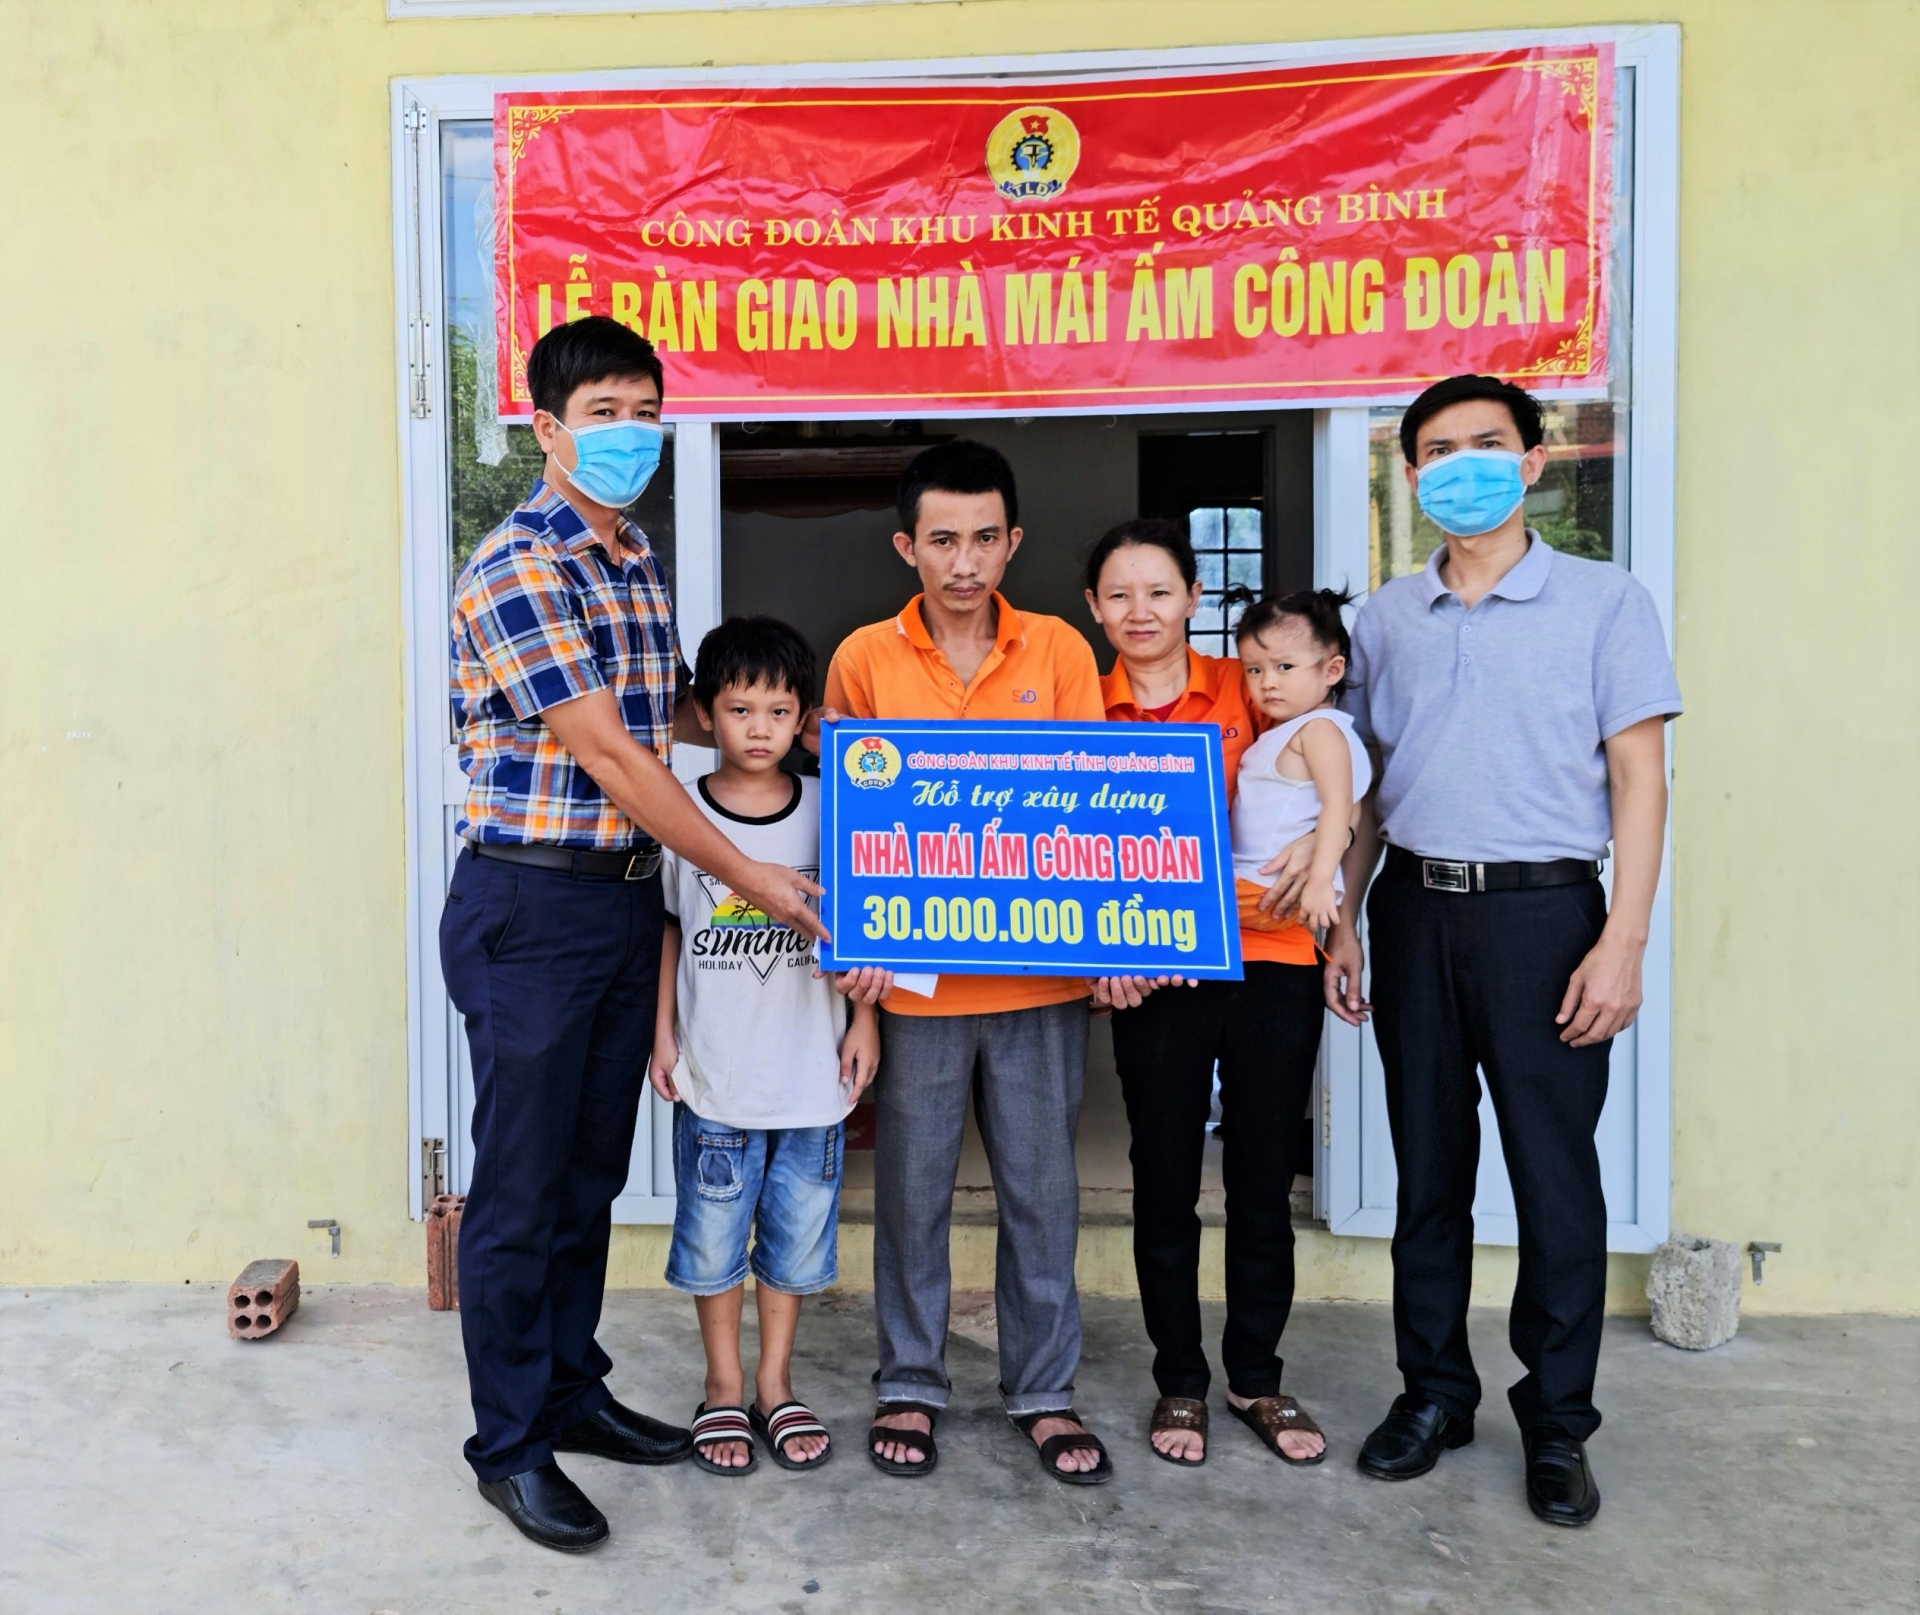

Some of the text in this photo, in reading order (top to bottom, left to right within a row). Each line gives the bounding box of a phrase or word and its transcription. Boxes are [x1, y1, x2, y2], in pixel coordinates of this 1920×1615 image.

[641, 184, 1447, 247] CÔNG ĐOÀN KHU KINH TẾ QUẢNG BÌNH
[612, 265, 717, 352] BÀN
[737, 278, 858, 351] GIAO
[877, 262, 987, 349] NHÀ
[1005, 255, 1107, 346] MÁI
[1126, 242, 1213, 342] ẤM
[1233, 247, 1385, 338] CÔNG
[1403, 236, 1565, 331] ĐOÀN
[907, 751, 946, 770] CÔNG
[947, 751, 988, 769] ĐOÀN
[989, 754, 1020, 770] KHU
[1020, 755, 1054, 771] KINH
[1054, 751, 1074, 771] TẾ
[1107, 752, 1159, 774] QUẢNG
[1159, 754, 1195, 773] BÌNH
[911, 780, 1169, 816] Hỗ trợ xây dựng
[852, 818, 1202, 883] NHÀ MÁI ẤM CÔNG ĐOÀN
[863, 894, 1197, 953] 30.000.000 đồng
[698, 960, 743, 971] HOLIDAY
[1282, 1409, 1297, 1417] VIP
